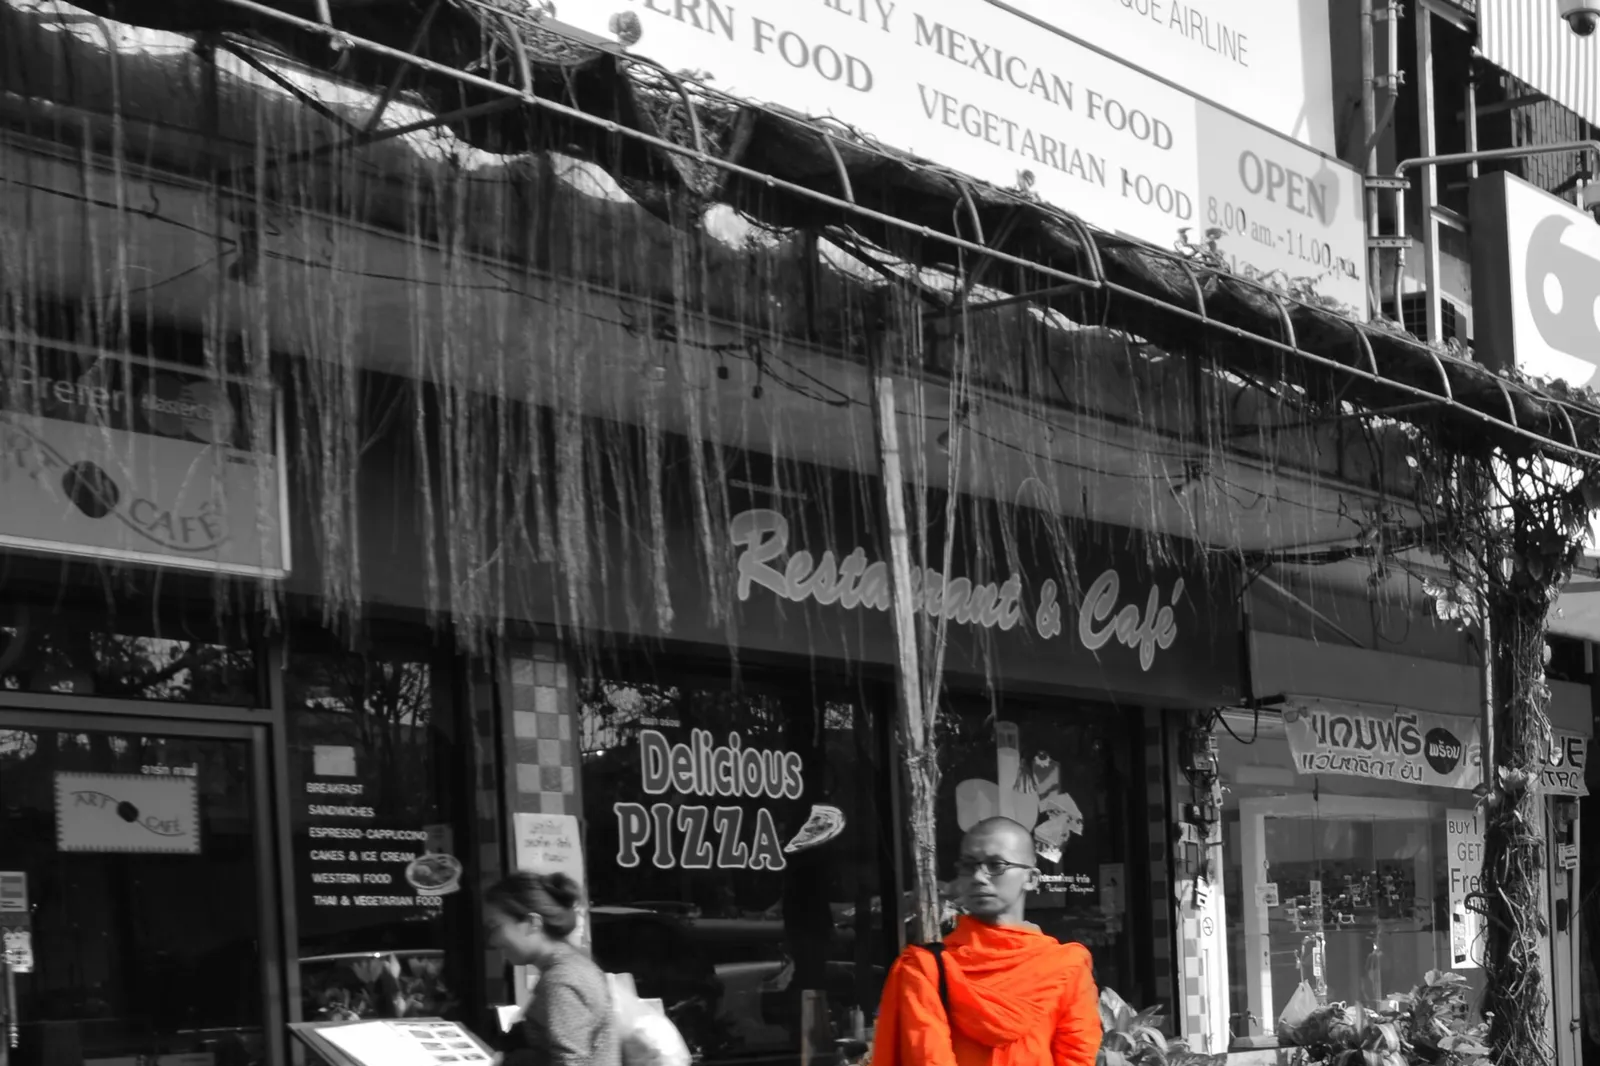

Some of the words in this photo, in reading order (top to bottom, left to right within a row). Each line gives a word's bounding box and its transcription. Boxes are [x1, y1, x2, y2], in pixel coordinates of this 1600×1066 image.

[1169, 0, 1248, 67] AIRLINE
[751, 16, 873, 93] FOOD
[913, 13, 1074, 111] MEXICAN
[1086, 88, 1173, 150] FOOD
[917, 82, 1106, 188] VEGETARIAN
[1120, 166, 1192, 220] FOOD
[1238, 150, 1328, 228] OPEN
[1207, 196, 1247, 237] 8.00
[1036, 578, 1061, 639] &
[1078, 570, 1185, 671] Café
[640, 728, 803, 800] Delicious
[1428, 739, 1461, 759] พร้อม
[306, 782, 364, 795] BREAKFAST
[308, 804, 375, 818] SANDWICHES
[1449, 820, 1470, 835] BUY
[613, 801, 787, 871] PIZZA
[1458, 842, 1482, 862] GET
[310, 850, 346, 862] CAKES
[348, 850, 359, 862] &
[361, 850, 378, 862] ICE
[380, 851, 416, 863] CREAM
[312, 873, 361, 885] WESTERN
[363, 873, 393, 885] FOOD
[1451, 867, 1482, 894] Fre
[313, 895, 338, 907] THAI
[340, 895, 351, 907] &
[353, 895, 413, 907] VEGETARIAN
[416, 896, 443, 907] FOOD
